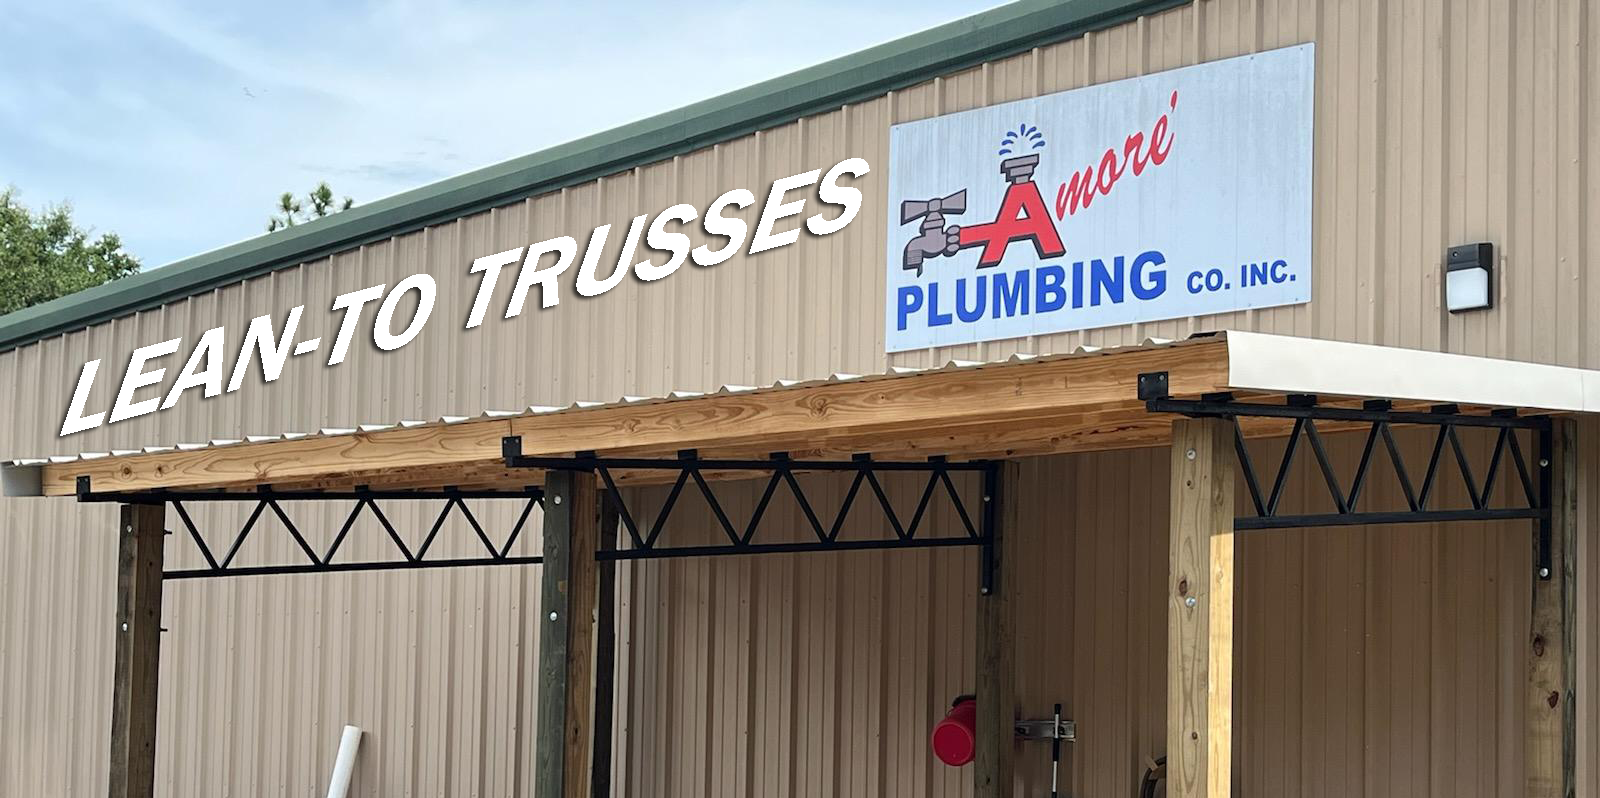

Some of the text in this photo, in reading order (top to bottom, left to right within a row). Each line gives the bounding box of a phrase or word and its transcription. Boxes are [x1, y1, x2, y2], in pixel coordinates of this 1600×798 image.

[897, 251, 1297, 331] PLUMBING CO. INC.
